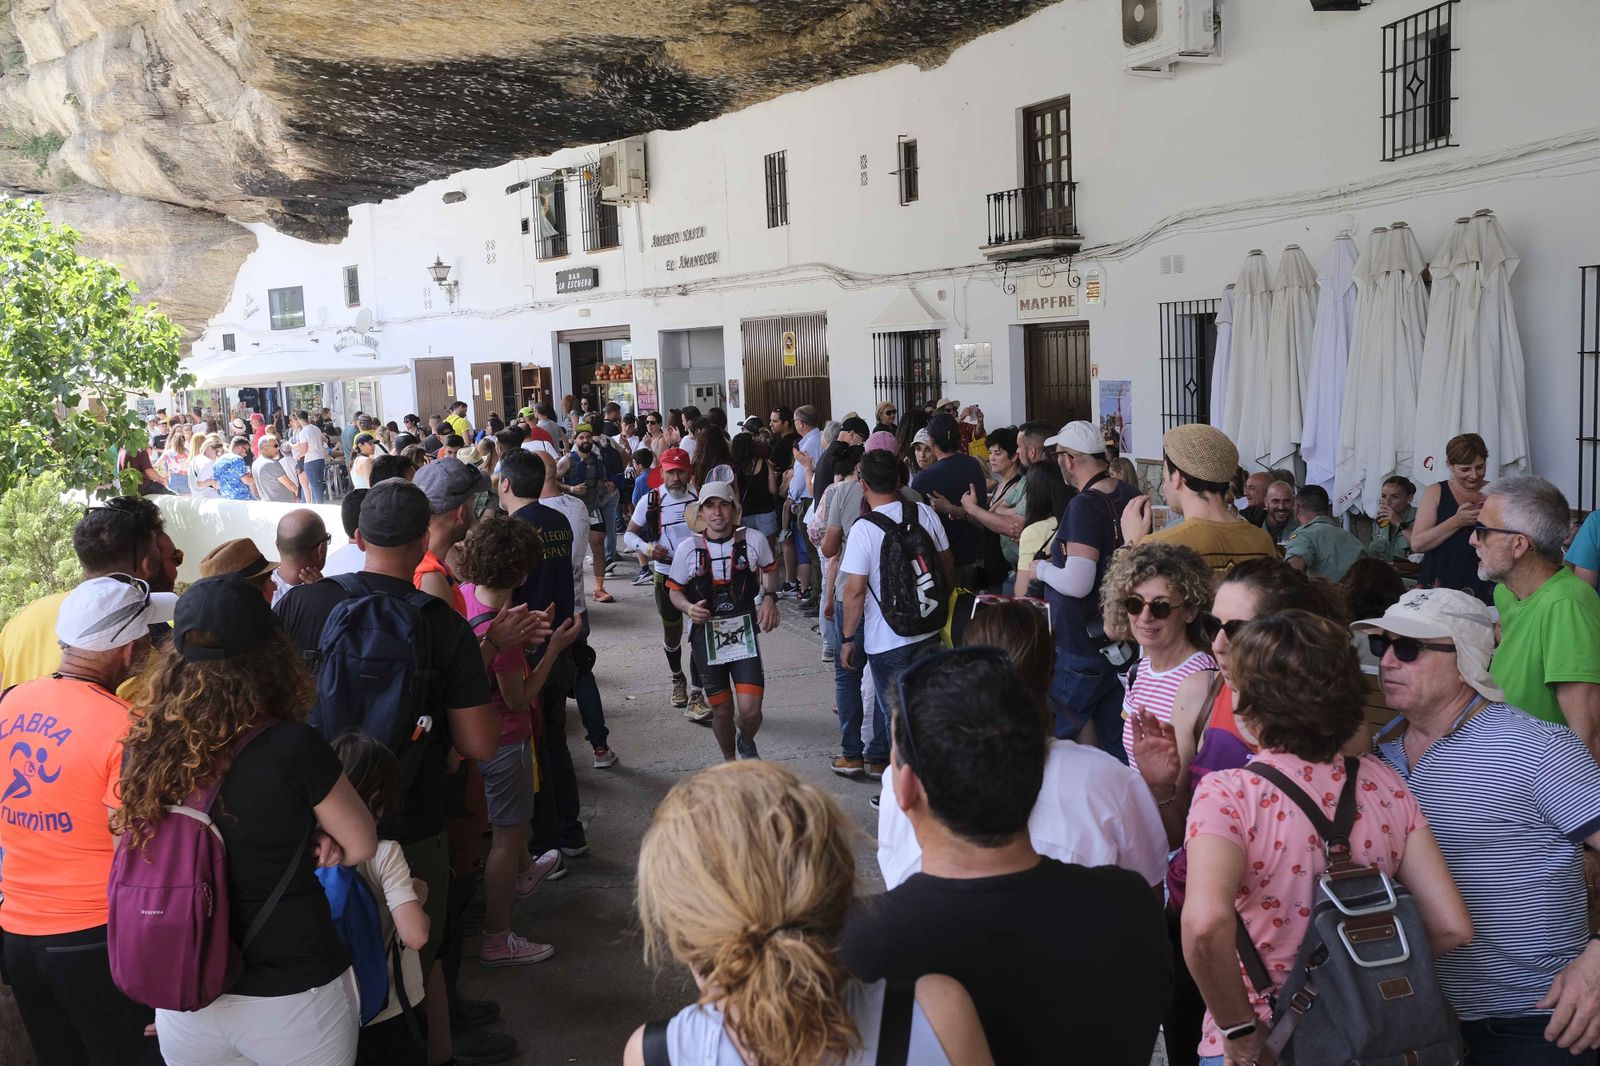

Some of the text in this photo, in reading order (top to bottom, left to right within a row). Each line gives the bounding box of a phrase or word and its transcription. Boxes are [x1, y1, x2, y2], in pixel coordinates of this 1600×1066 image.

[679, 251, 718, 269] AMANECER
[558, 280, 565, 290] LA
[568, 272, 581, 280] BAR
[1019, 294, 1076, 312] MAPFRE
[911, 554, 939, 618] FILA
[0, 712, 73, 747] CABRA
[1, 805, 74, 834] running
